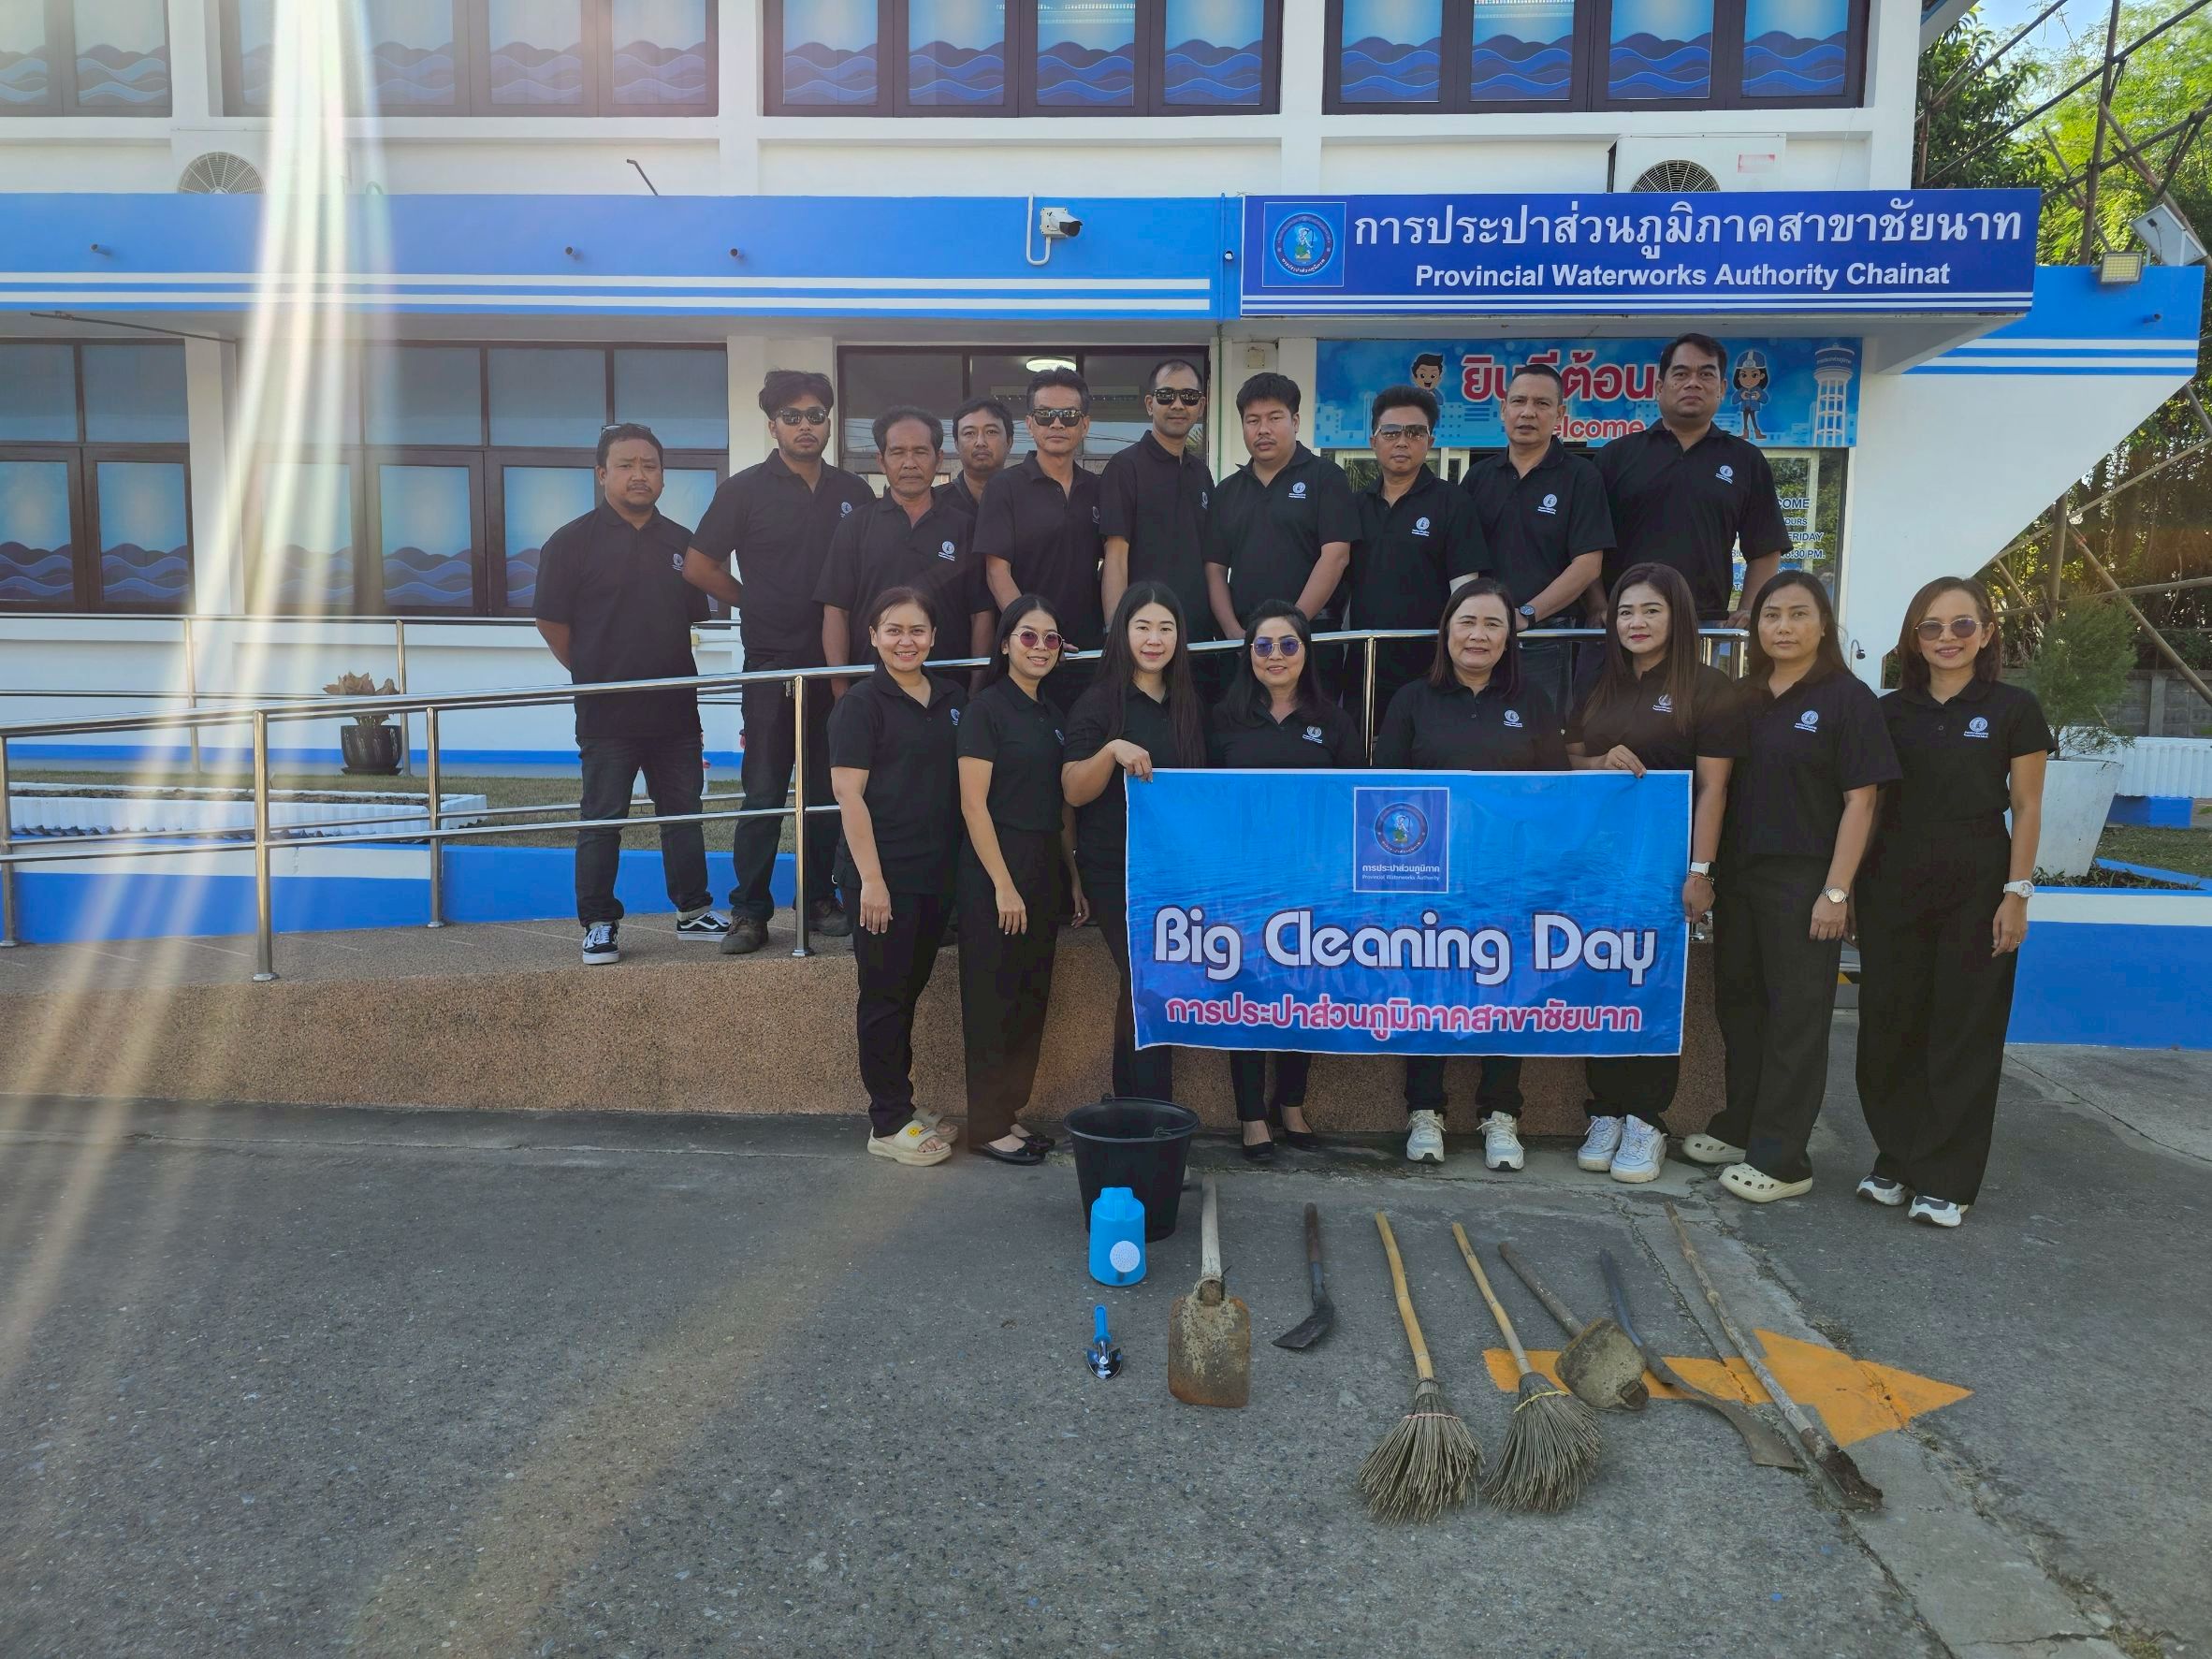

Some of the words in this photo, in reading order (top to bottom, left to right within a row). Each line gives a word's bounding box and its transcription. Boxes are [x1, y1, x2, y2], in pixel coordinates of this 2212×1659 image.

[1354, 197, 2021, 259] การประปาส่วนภูมิภาคสาขาชัยนาท
[1416, 265, 1544, 286] Provincial
[1551, 264, 1707, 286] Waterworks
[1714, 263, 1839, 290] Authority
[1846, 262, 1950, 284] Chainat
[1550, 415, 1647, 439] elcome
[1155, 906, 1242, 982] Big
[1265, 910, 1511, 985] Cleaning
[1534, 913, 1655, 985] Day
[1167, 992, 1641, 1041] การประปาส่วนภูมิภาคสาขาชัยนาท
